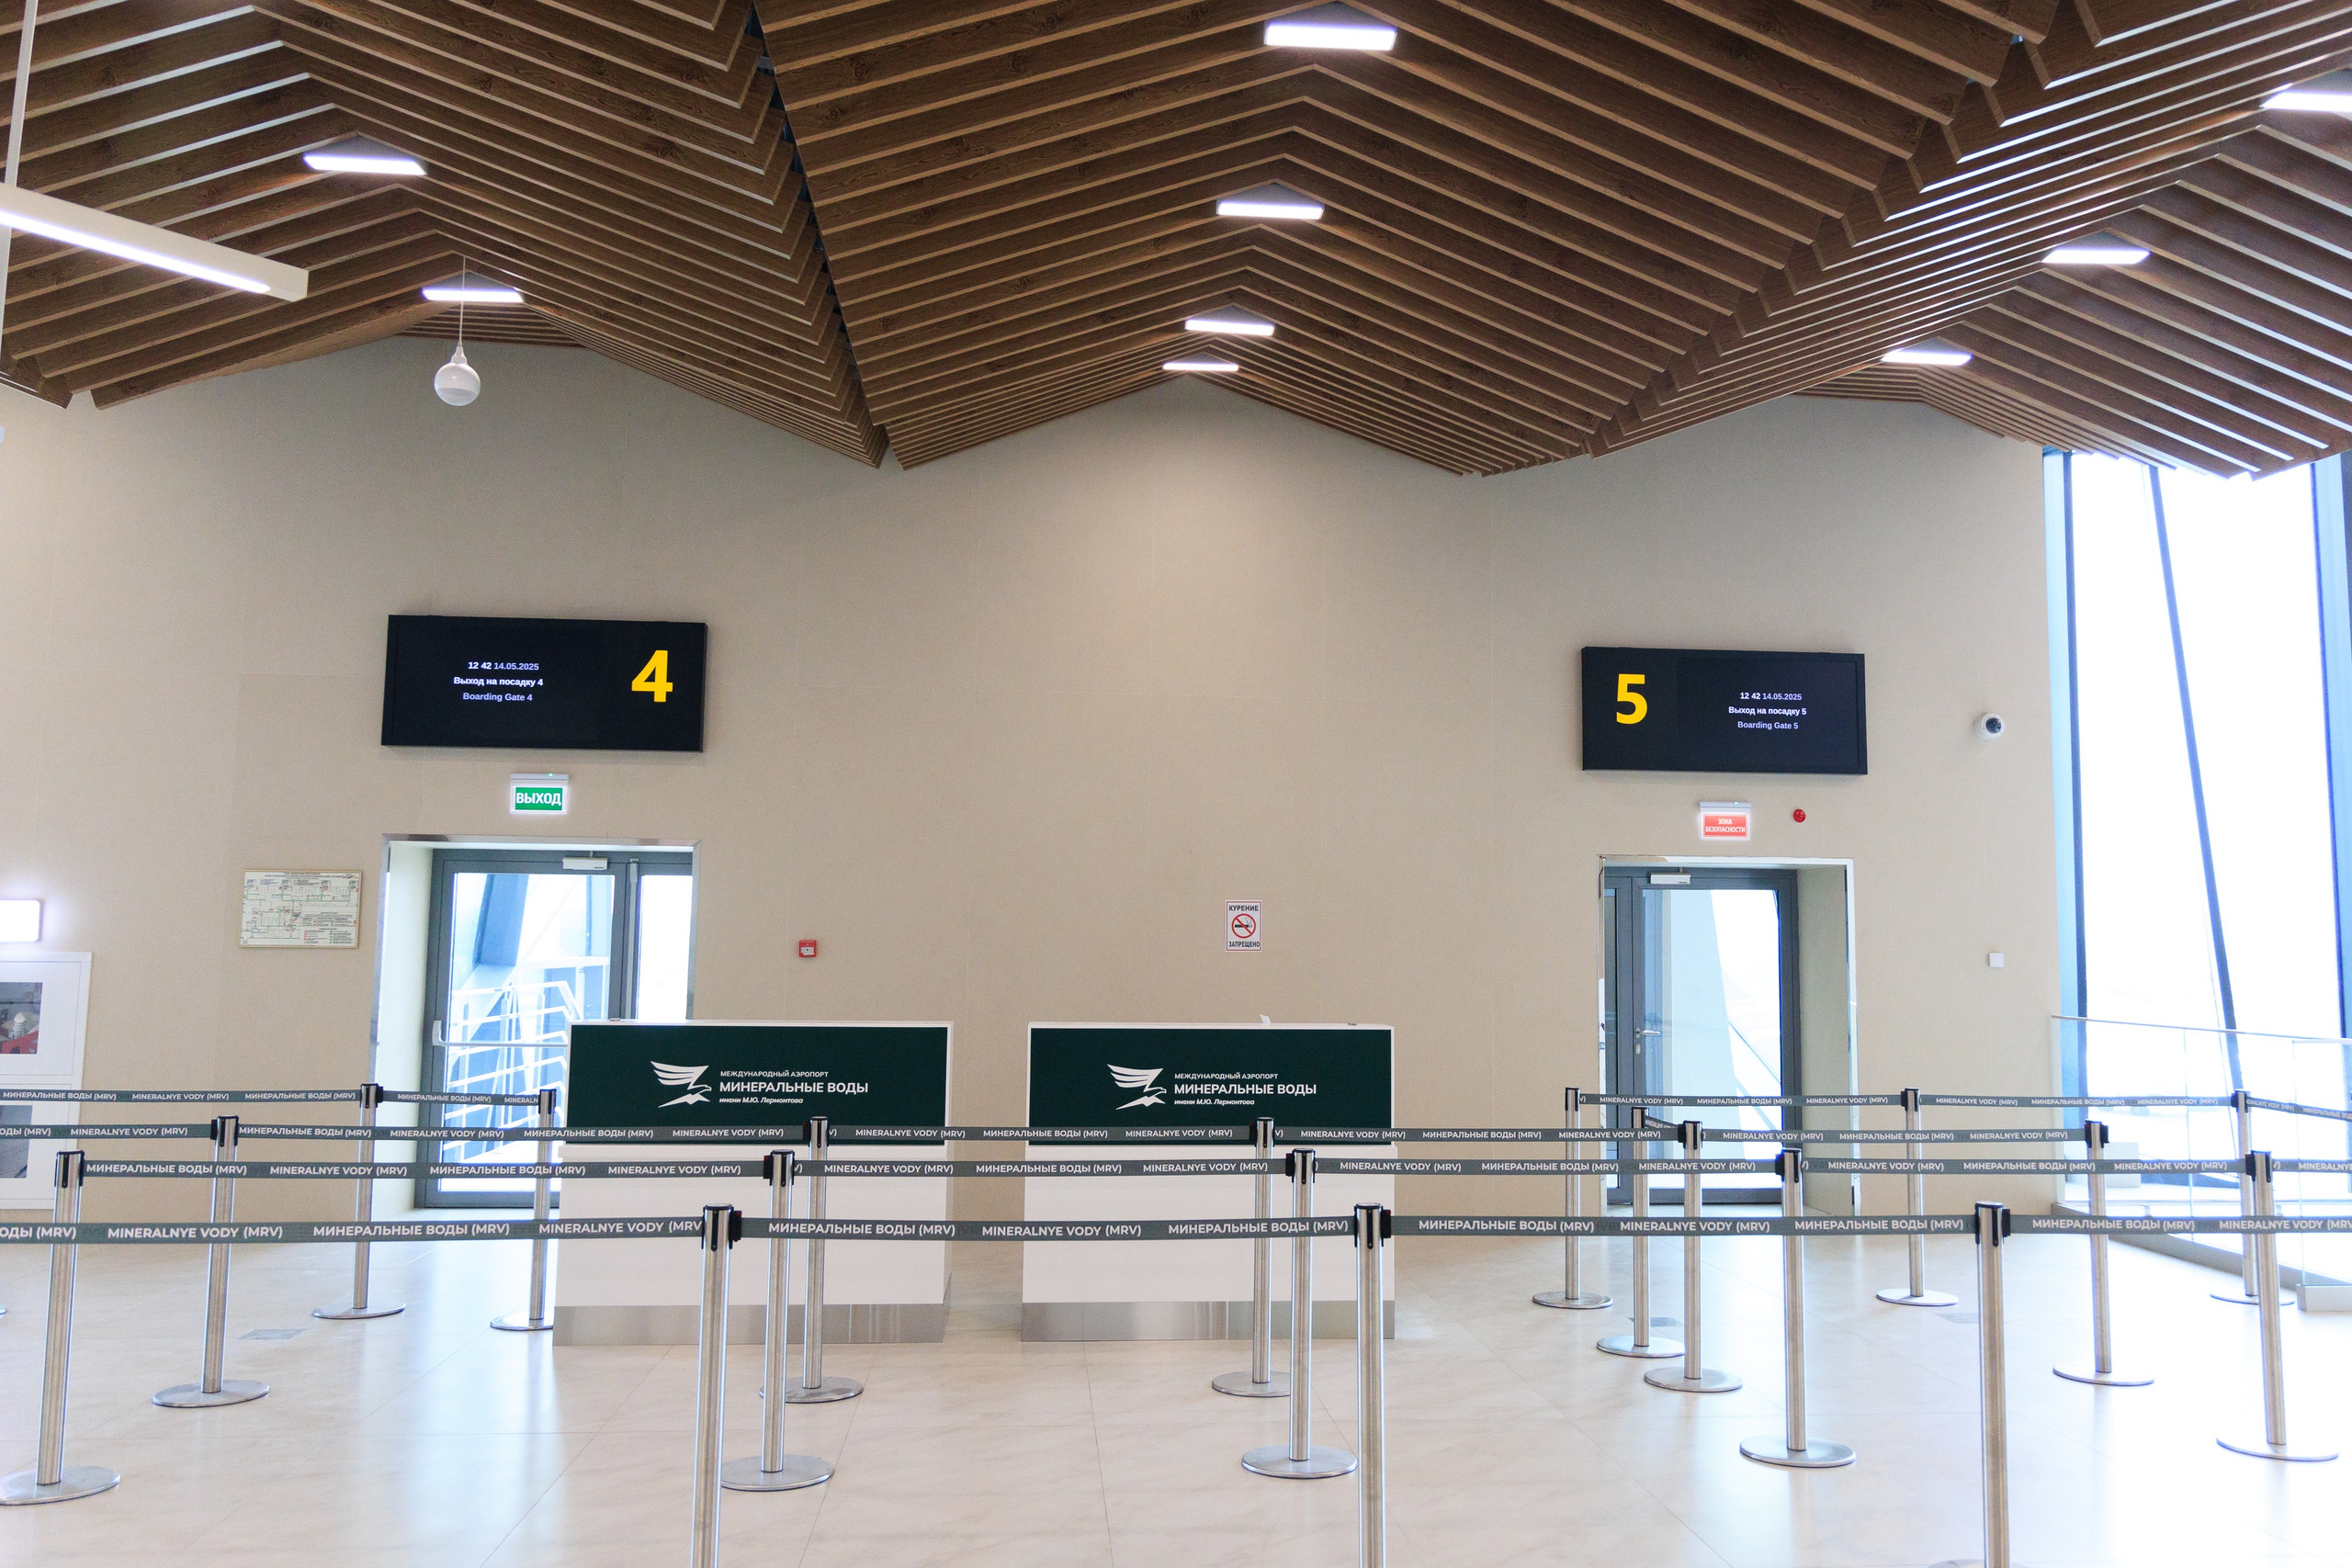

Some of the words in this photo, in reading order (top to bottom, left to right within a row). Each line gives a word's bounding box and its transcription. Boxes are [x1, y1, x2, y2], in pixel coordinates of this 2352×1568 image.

[468, 661, 480, 670] 12
[481, 661, 492, 670] 42
[493, 662, 539, 671] 14.05.2025
[631, 649, 673, 703] 4
[453, 677, 484, 687] Выход
[499, 679, 536, 689] посадку
[537, 678, 544, 686] 4
[463, 693, 503, 703] Boarding
[504, 693, 526, 702] Gate
[526, 694, 533, 702] 4
[1615, 673, 1648, 725] 5
[1739, 692, 1749, 700] 12
[1751, 692, 1761, 700] 42
[1762, 693, 1803, 701] 14.05.2025
[1728, 706, 1756, 716] Выход
[1768, 708, 1800, 717] посадку
[1737, 721, 1772, 730] Boarding
[1774, 721, 1792, 729] Gate
[516, 792, 562, 807] ВЫХОД
[1228, 941, 1261, 949] ЗАПРЕЩЕНО
[719, 1069, 789, 1078] МЕЖДУНАРОДНЫЙ
[790, 1070, 829, 1078] АЭРОПОРТ
[1174, 1072, 1241, 1080] МЕЖДУНАРОДНЫЙ
[719, 1081, 824, 1093] МИНЕРАЛЬНЫЕ
[827, 1082, 869, 1095] ВОДЫ
[1174, 1083, 1274, 1095] МИНЕРАЛЬНЫЕ
[1277, 1084, 1317, 1097] ВОДЫ
[67, 1092, 93, 1100] ВОДЫ
[93, 1092, 118, 1101] (MRV)
[760, 1097, 804, 1105] Лермонтова
[1600, 1096, 1644, 1104] MINERALNYE
[1664, 1098, 1684, 1106] (MRV)
[1214, 1099, 1255, 1107] Лермонтова
[23, 1127, 51, 1137] (MRV)
[161, 1127, 188, 1136] (MRV)
[239, 1126, 313, 1135] МИНЕРАЛЬНЫЕ
[314, 1128, 344, 1137] ВОДЫ
[345, 1128, 372, 1138] (MRV)
[478, 1130, 504, 1139] (MRV)
[672, 1129, 729, 1137] MINERALNYE
[758, 1128, 784, 1138] (MRV)
[855, 1129, 911, 1137] MINERALNYE
[913, 1129, 938, 1137] VODY
[940, 1130, 966, 1139] (MRV)
[1054, 1130, 1081, 1138] ВОДЫ
[1082, 1130, 1108, 1139] (MRV)
[1300, 1130, 1354, 1138] MINERALNYE
[1382, 1130, 1407, 1140] (MRV)
[1490, 1131, 1517, 1140] ВОДЫ
[1518, 1131, 1542, 1140] (MRV)
[1723, 1132, 1774, 1140] MINERALNYE
[1800, 1133, 1824, 1142] (MRV)
[1905, 1133, 1929, 1141] ВОДЫ
[1930, 1133, 1954, 1141] (MRV)
[86, 1164, 176, 1173] МИНЕРАЛЬНЫЕ
[177, 1164, 213, 1175] ВОДЫ
[215, 1165, 247, 1176] (MRV)
[269, 1166, 340, 1175] MINERALNYE
[342, 1166, 374, 1175] VODY
[376, 1166, 408, 1177] (MRV)
[430, 1166, 516, 1175] МИНЕРАЛЬНЫЕ
[518, 1166, 552, 1176] ВОДЫ
[555, 1166, 586, 1177] (MRV)
[608, 1166, 676, 1175] MINERALNYE
[677, 1166, 708, 1174] VODY
[710, 1165, 741, 1176] (MRV)
[824, 1164, 890, 1173] MINERALNYE
[892, 1165, 922, 1173] VODY
[924, 1164, 954, 1175] (MRV)
[976, 1164, 1057, 1173] МИНЕРАЛЬНЫЕ
[1059, 1164, 1091, 1174] ВОДЫ
[1092, 1164, 1122, 1175] (MRV)
[1143, 1163, 1206, 1172] MINERALNYE
[1208, 1163, 1237, 1171] VODY
[1239, 1162, 1268, 1172] (MRV)
[1340, 1161, 1402, 1170] MINERALNYE
[1403, 1162, 1431, 1171] VODY
[1433, 1162, 1462, 1173] (MRV)
[1481, 1162, 1558, 1171] МИНЕРАЛЬНЫЕ
[1560, 1162, 1589, 1172] ВОДЫ
[1591, 1162, 1619, 1173] (MRV)
[1638, 1162, 1699, 1170] MINERALNYE
[1700, 1162, 1727, 1170] VODY
[1728, 1161, 1756, 1172] (MRV)
[1827, 1161, 1887, 1170] MINERALNYE
[1888, 1162, 1916, 1170] VODY
[1917, 1162, 1945, 1172] (MRV)
[1963, 1162, 2037, 1170] МИНЕРАЛЬНЫЕ
[2038, 1162, 2067, 1171] ВОДЫ
[2069, 1162, 2096, 1172] (MRV)
[2114, 1162, 2172, 1170] MINERALNYE
[2173, 1161, 2199, 1170] VODY
[2201, 1161, 2228, 1171] (MRV)
[312, 1224, 423, 1236] МИНЕРАЛЬНЫЕ
[425, 1224, 469, 1236] ВОДЫ
[471, 1223, 510, 1236] (MRV)
[538, 1223, 624, 1234] MINERALNYE
[627, 1222, 664, 1233] VODY
[668, 1220, 702, 1234] (MRV
[768, 1223, 873, 1235] МИНЕРАЛЬНЫЕ
[876, 1224, 916, 1236] ВОДЫ
[919, 1224, 956, 1237] (MRV)
[1168, 1223, 1269, 1235] МИНЕРАЛЬНЫЕ
[1271, 1221, 1310, 1234] ВОДЫ
[1313, 1220, 1349, 1234] (MRV)
[1419, 1220, 1517, 1230] МИНЕРАЛЬНЫЕ
[1519, 1220, 1557, 1232] ВОДЫ
[1559, 1221, 1595, 1234] (MRV)
[1620, 1221, 1697, 1232] MINERALNYE
[1699, 1221, 1733, 1232] VODY
[1736, 1221, 1770, 1234] (MRV)
[1794, 1220, 1889, 1230] МИНЕРАЛЬНЫЕ
[1891, 1219, 1928, 1231] ВОДЫ
[1930, 1219, 1964, 1232] (MRV)
[2032, 1219, 2123, 1229] МИНЕРАЛЬНЫЕ
[2125, 1219, 2161, 1231] ВОДЫ
[2163, 1220, 2195, 1232] (MRV)
[2219, 1219, 2290, 1230] MINERALNYE
[2292, 1219, 2324, 1230] VODY
[36, 1225, 77, 1240] (MRV)
[107, 1227, 198, 1238] MINERALNYE
[199, 1227, 240, 1238] VODY
[243, 1225, 283, 1239] (MRV)
[982, 1225, 1064, 1236] MINERALNYE
[1066, 1225, 1102, 1236] VODY
[1105, 1224, 1142, 1237] (MRV)
